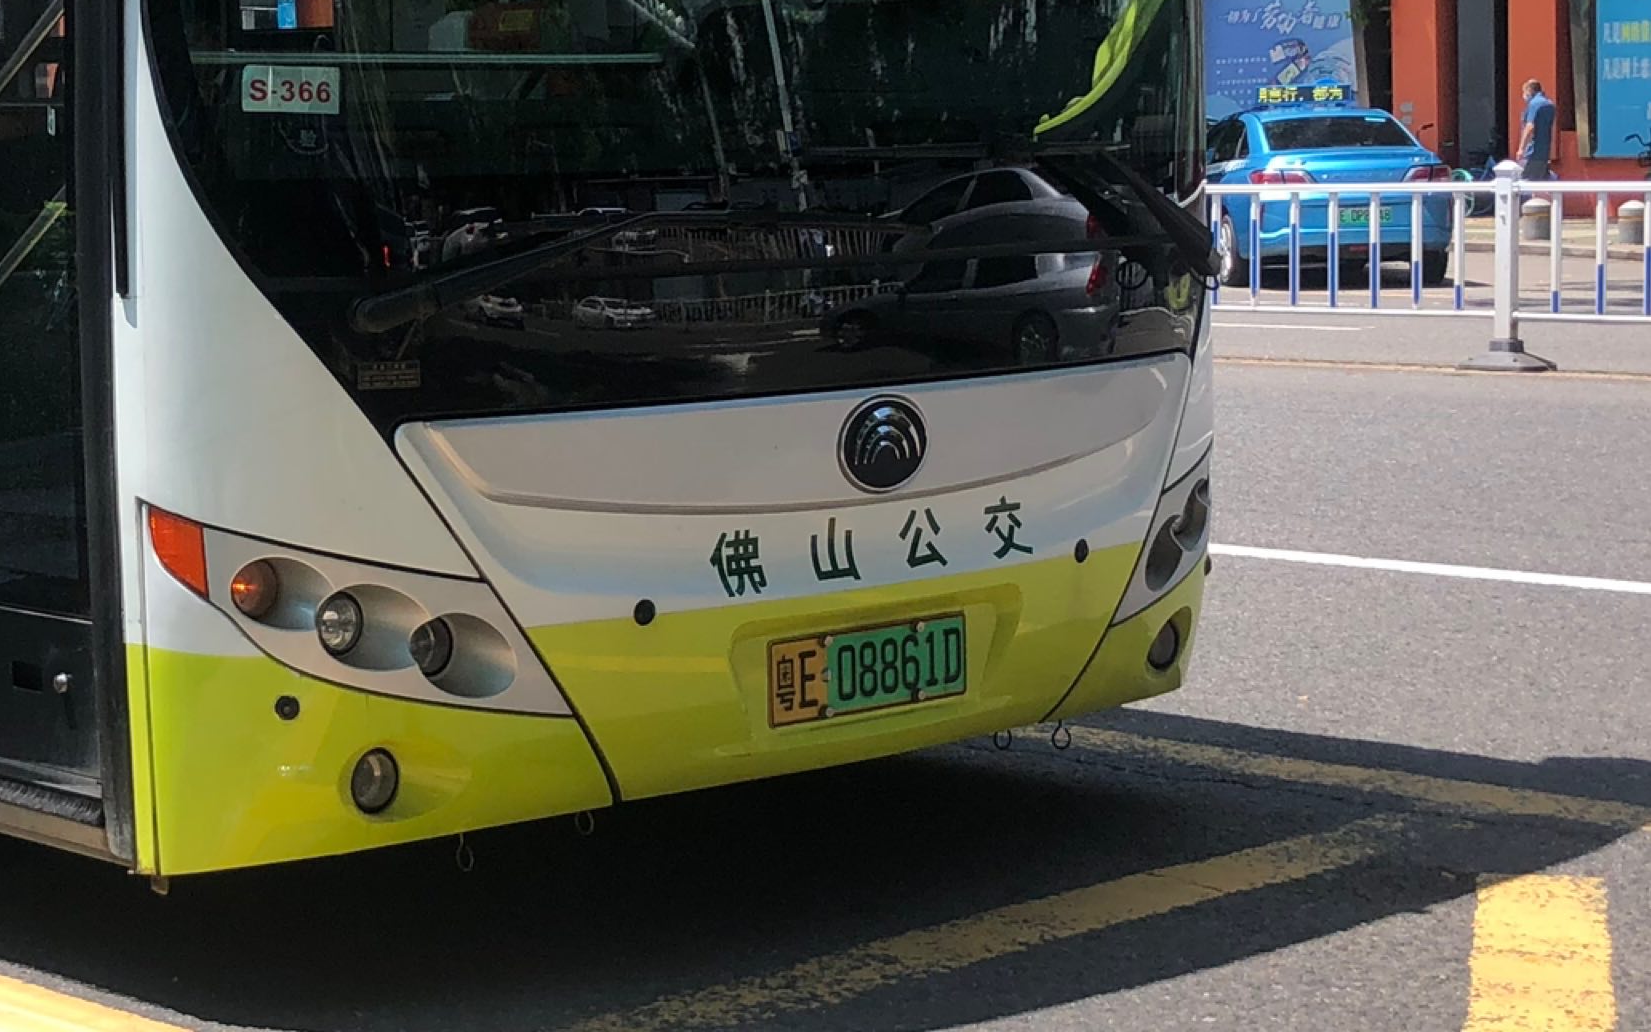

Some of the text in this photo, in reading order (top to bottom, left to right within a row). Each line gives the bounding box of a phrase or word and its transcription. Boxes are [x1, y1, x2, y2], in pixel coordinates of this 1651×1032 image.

[249, 79, 331, 103] S-366
[709, 495, 1034, 598] 佛山公交
